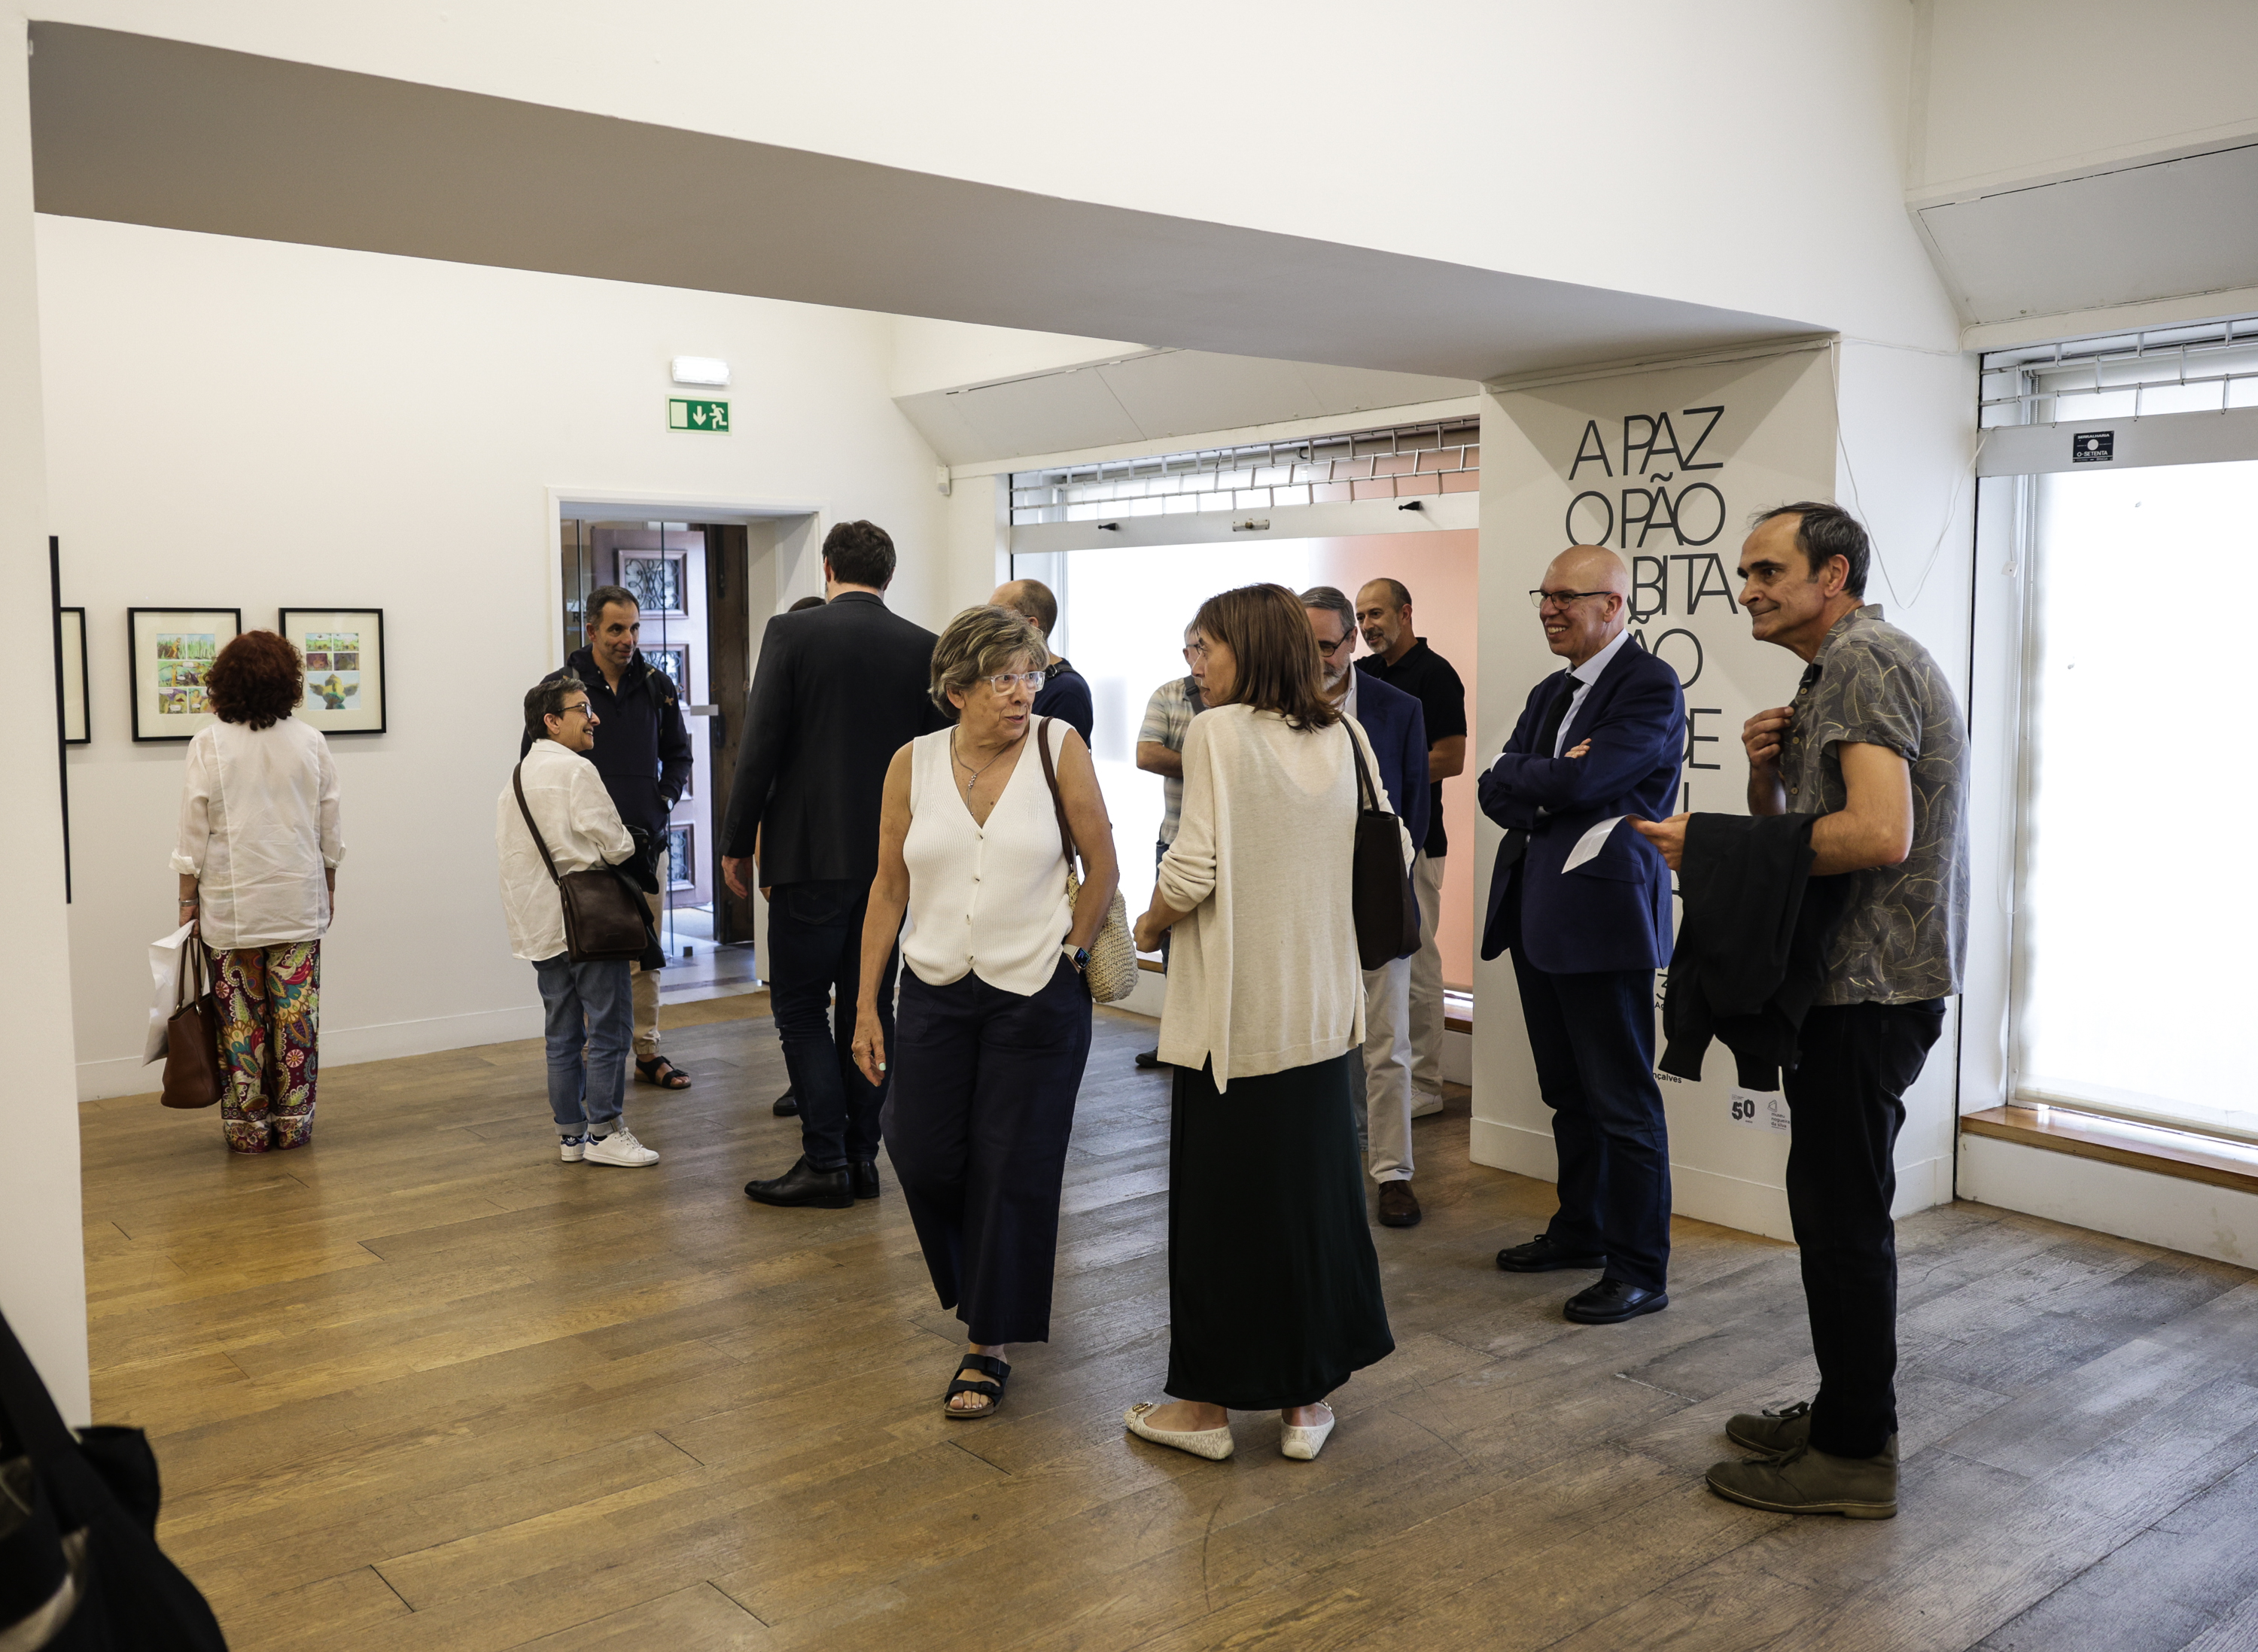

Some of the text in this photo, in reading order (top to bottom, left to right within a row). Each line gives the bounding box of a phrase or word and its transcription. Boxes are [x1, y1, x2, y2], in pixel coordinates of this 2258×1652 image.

[1569, 405, 1724, 480] A PAZ
[1566, 471, 1726, 549] O PÃO
[1627, 552, 1739, 616] BITA
[1731, 1099, 1755, 1121] 50
